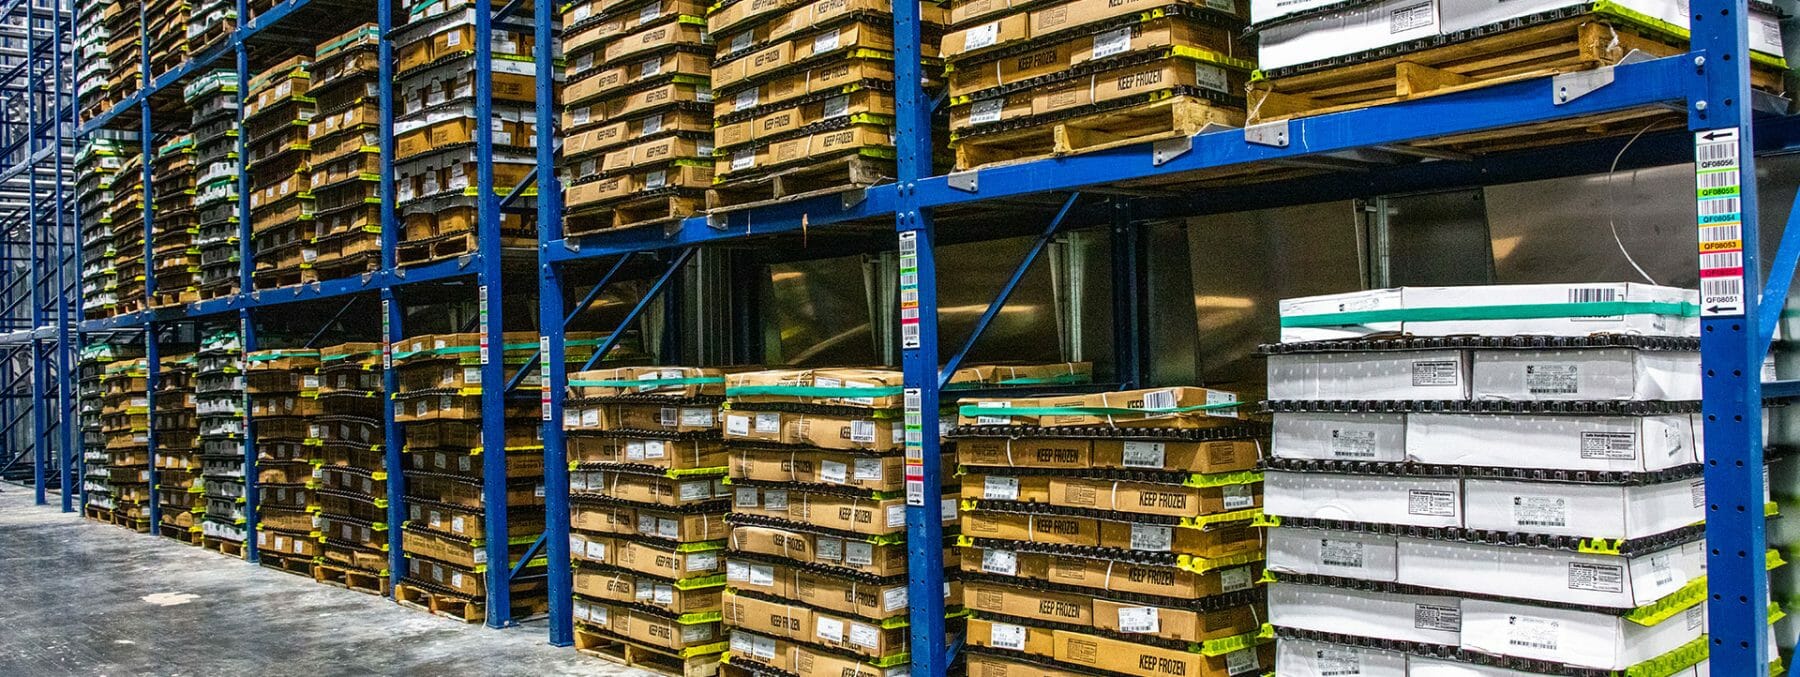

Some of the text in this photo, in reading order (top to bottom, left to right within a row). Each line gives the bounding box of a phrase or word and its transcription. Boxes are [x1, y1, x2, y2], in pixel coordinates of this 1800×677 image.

[1018, 50, 1057, 71] KEEP FROZEN
[1118, 69, 1163, 91] KEEP FROZEN
[1701, 159, 1735, 169] QF08056
[1702, 187, 1735, 196] QF08055
[1704, 241, 1737, 250] QF08053
[1706, 296, 1738, 304] QF08051
[1037, 448, 1079, 463] KEEP FROZEN
[1139, 491, 1187, 509] KEEP FROZEN
[1037, 518, 1080, 535] KEEP FROZEN
[1128, 567, 1175, 586] KEEP FROZEN
[1039, 600, 1080, 618] KEEP FROZEN
[1139, 654, 1187, 676] KEEP FROZEN
